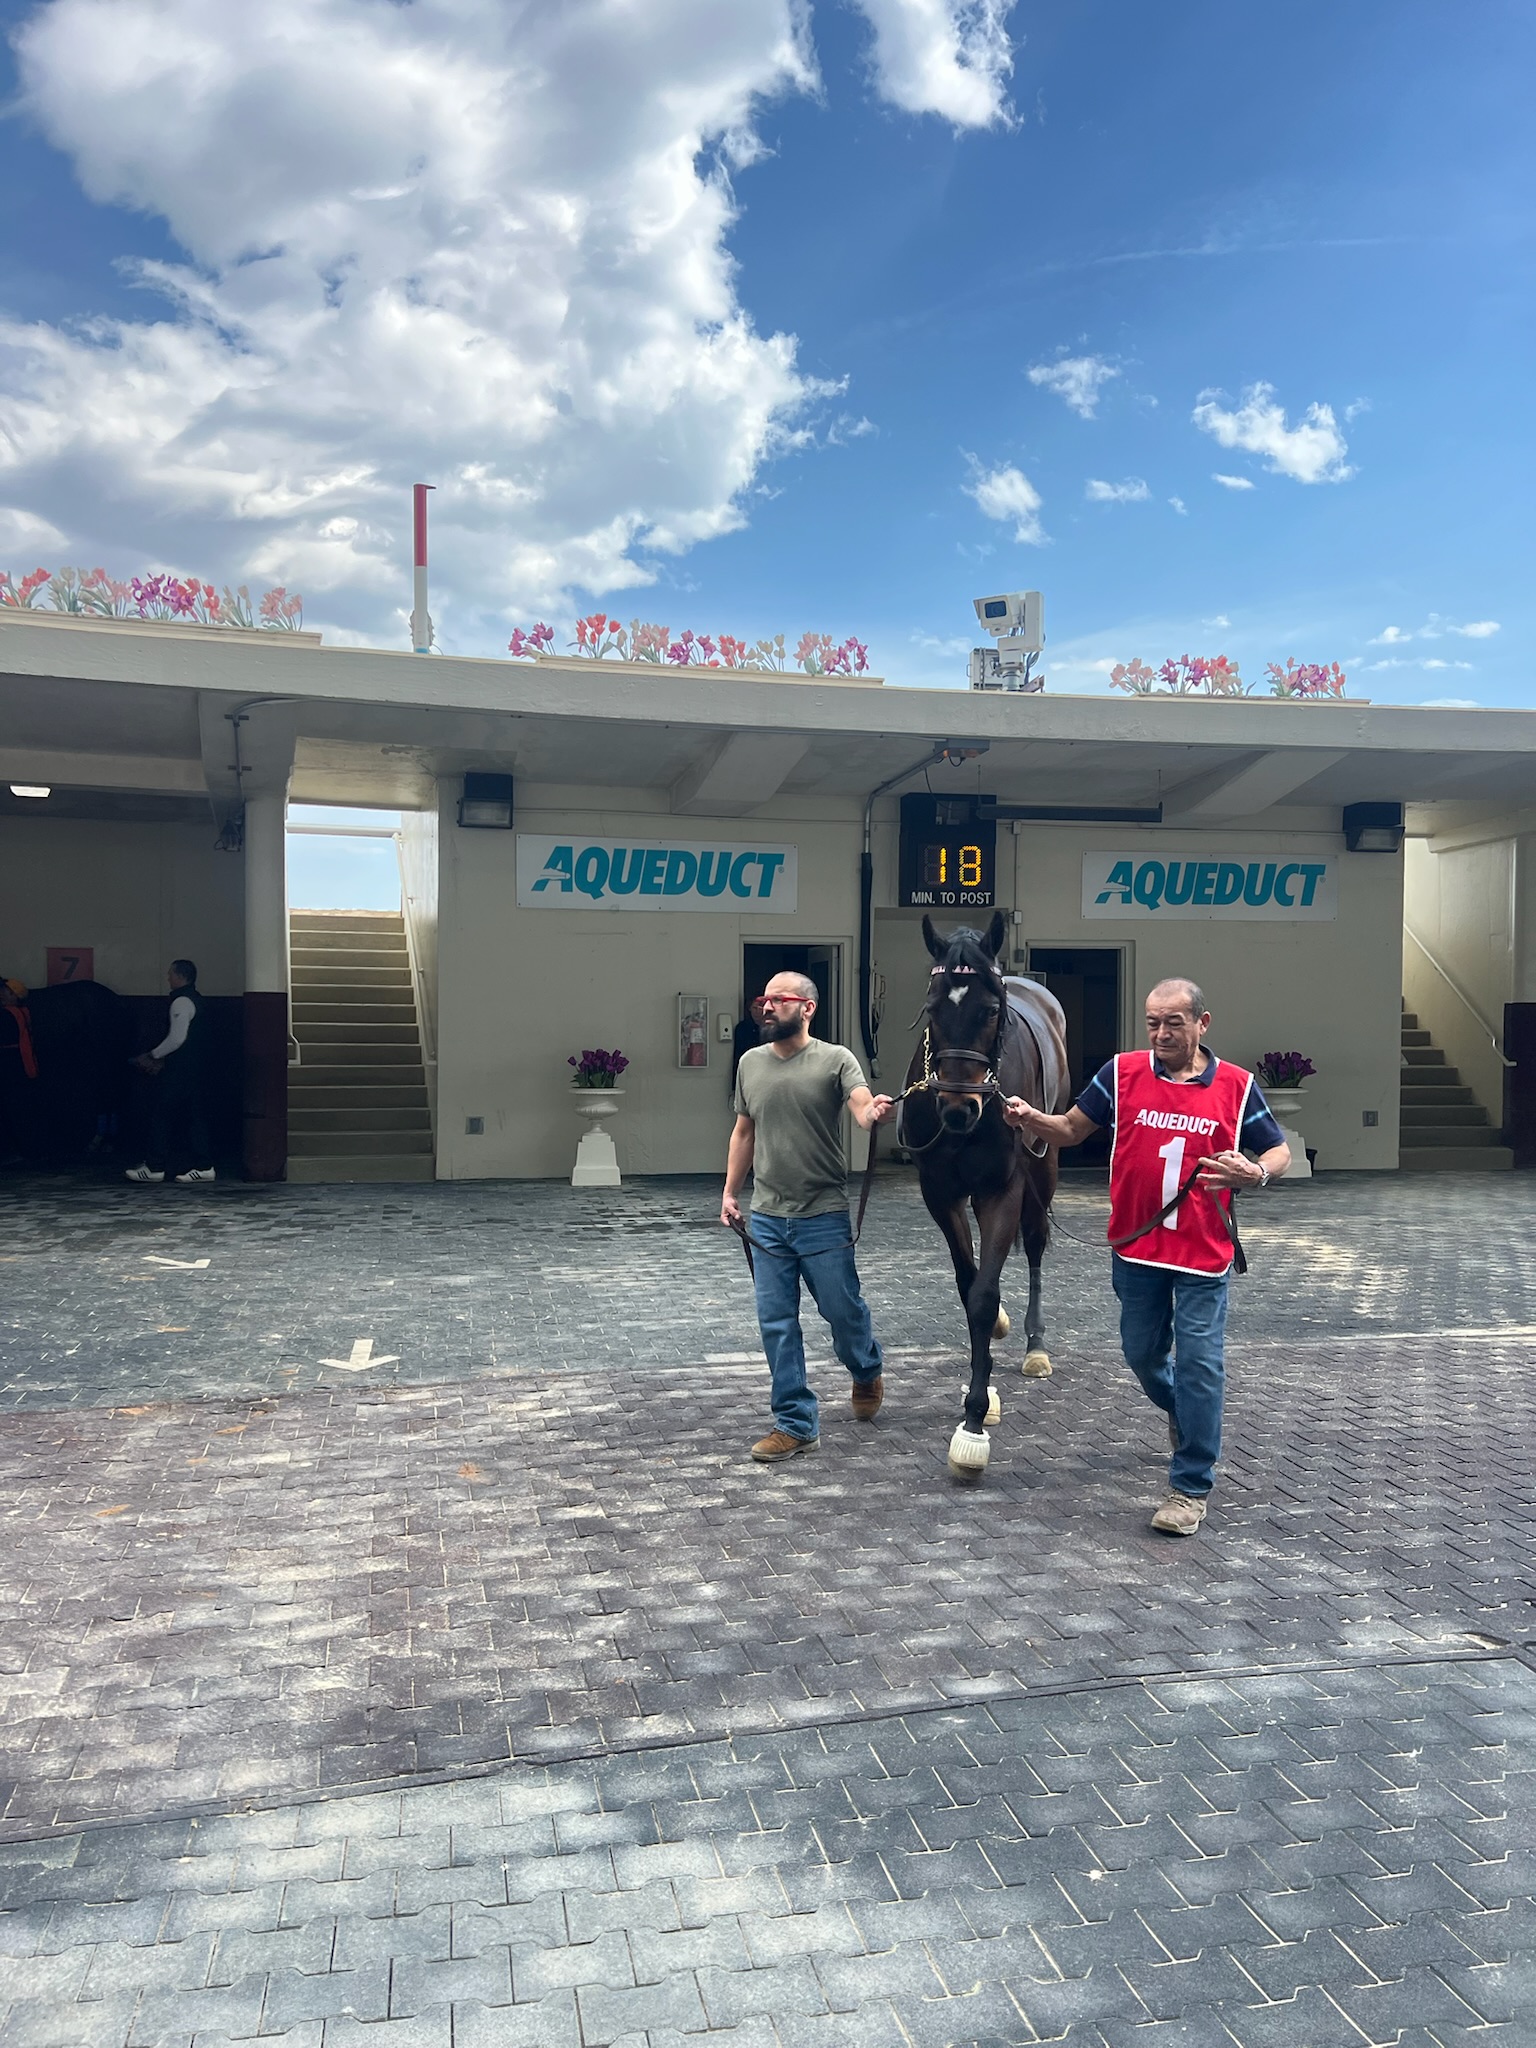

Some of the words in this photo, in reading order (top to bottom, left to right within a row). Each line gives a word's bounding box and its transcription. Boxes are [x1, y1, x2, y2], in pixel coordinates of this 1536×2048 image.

[530, 845, 785, 900] AQUEDUCT
[939, 845, 982, 887] 18
[1094, 860, 1326, 911] AQUEDUCT
[911, 891, 936, 904] MIN.
[940, 891, 956, 904] TO
[960, 892, 991, 904] POST
[61, 956, 80, 980] 7
[1134, 1108, 1219, 1137] AQUEDUCT
[1158, 1136, 1187, 1231] 1
